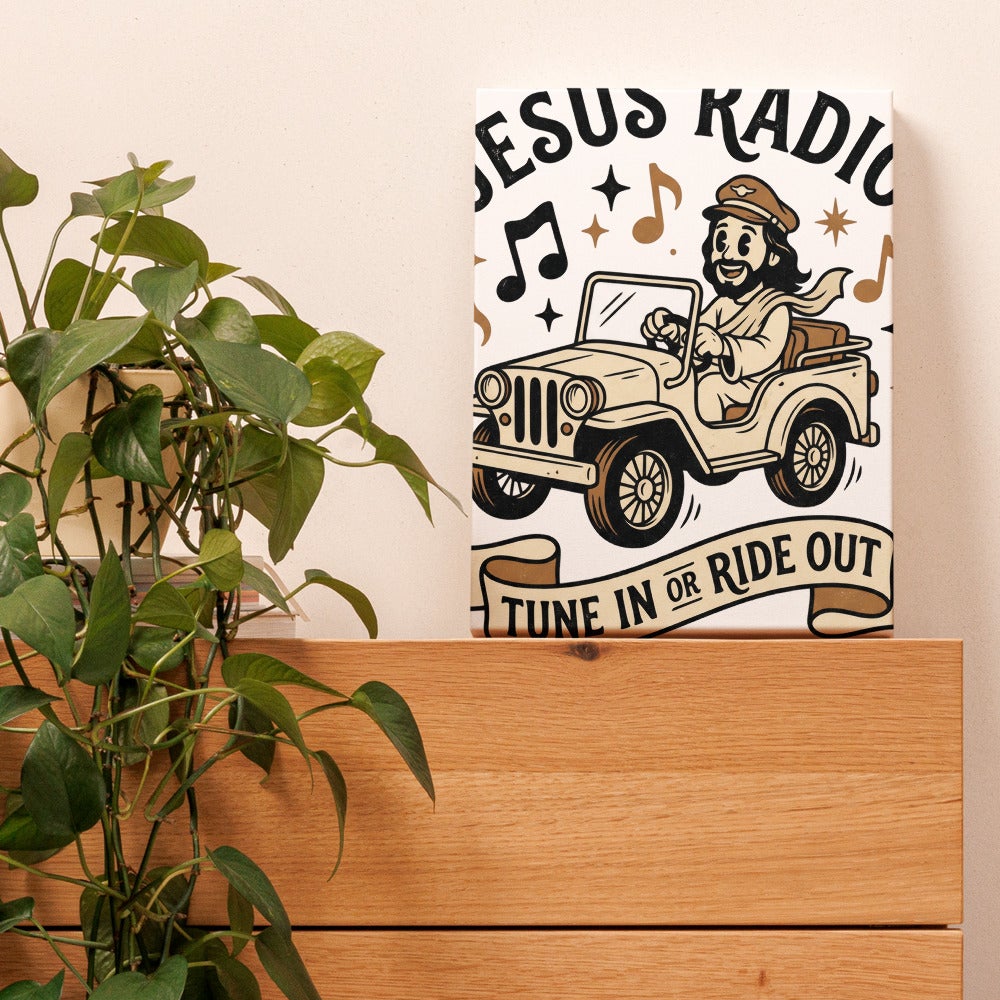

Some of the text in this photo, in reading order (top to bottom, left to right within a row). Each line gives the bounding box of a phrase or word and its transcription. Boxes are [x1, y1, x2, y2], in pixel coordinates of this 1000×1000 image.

[501, 532, 881, 638] TUNE IN OR RIDE OUT
